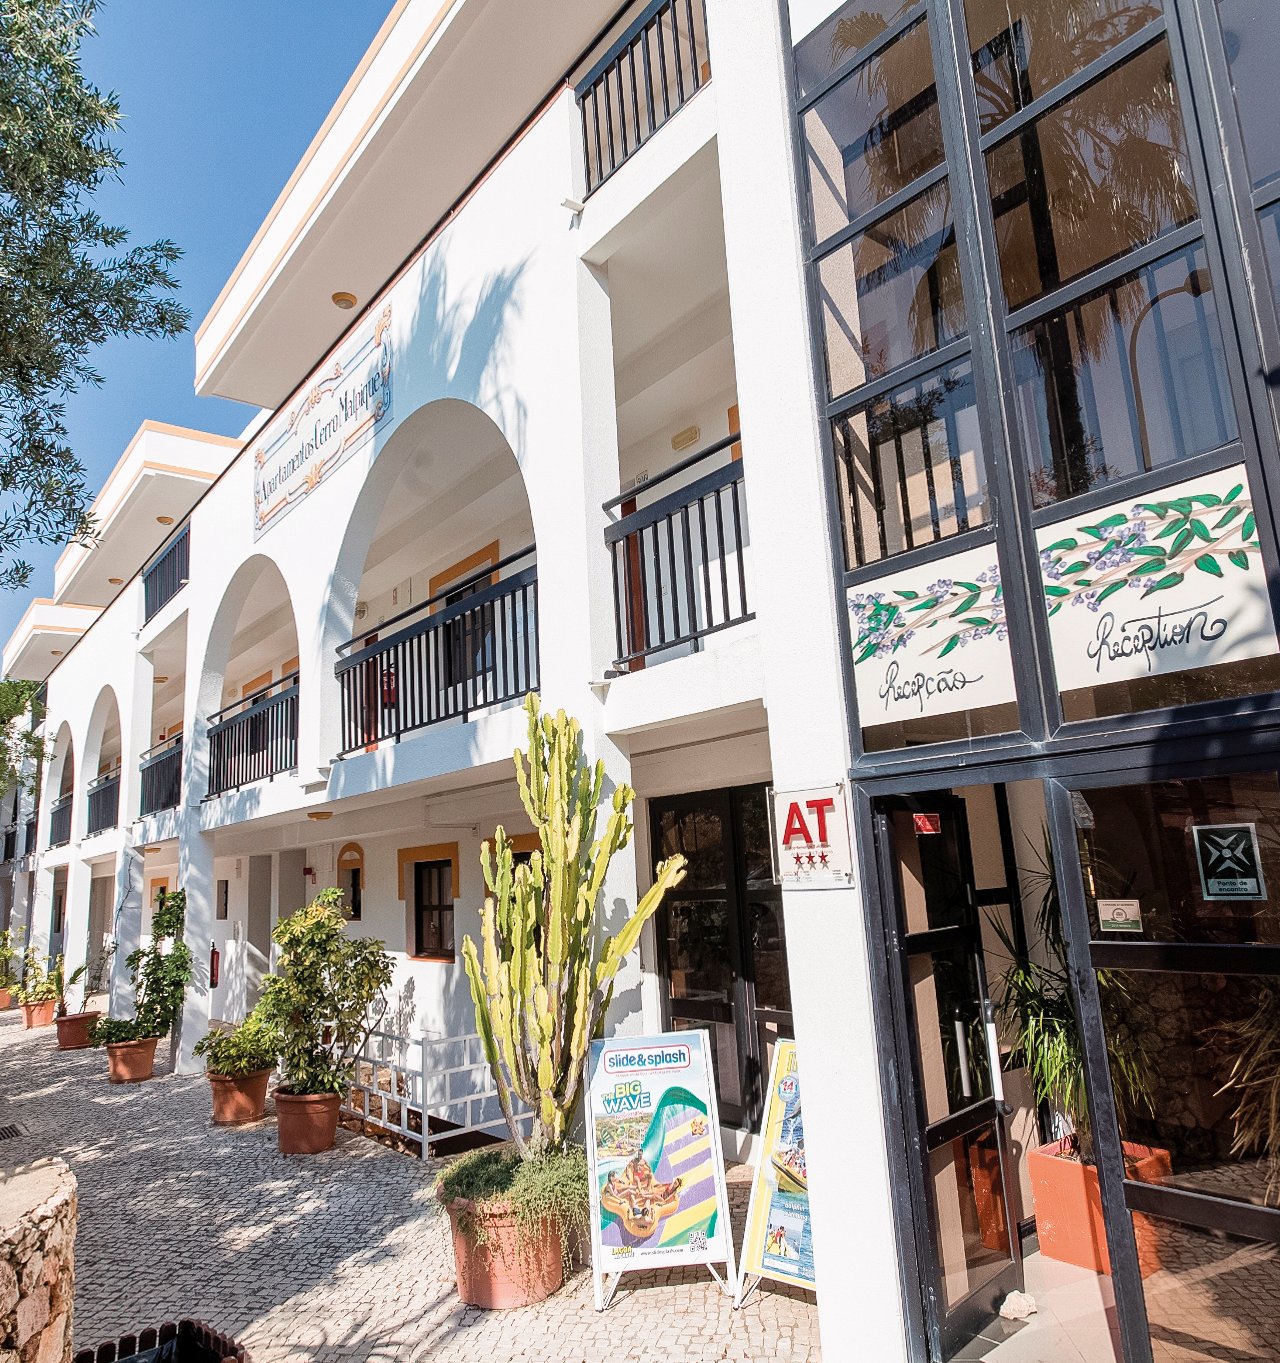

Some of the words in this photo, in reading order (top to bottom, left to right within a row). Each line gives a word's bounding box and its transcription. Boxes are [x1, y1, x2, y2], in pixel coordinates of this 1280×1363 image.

[261, 438, 314, 505] Apartamentos
[313, 413, 339, 450] Cerro
[1086, 594, 1228, 674] Reception
[878, 659, 984, 713] Recepção
[782, 797, 834, 846] AT
[608, 1049, 687, 1069] slide&splash
[602, 1092, 652, 1115] WAVE
[614, 1080, 642, 1099] BIG
